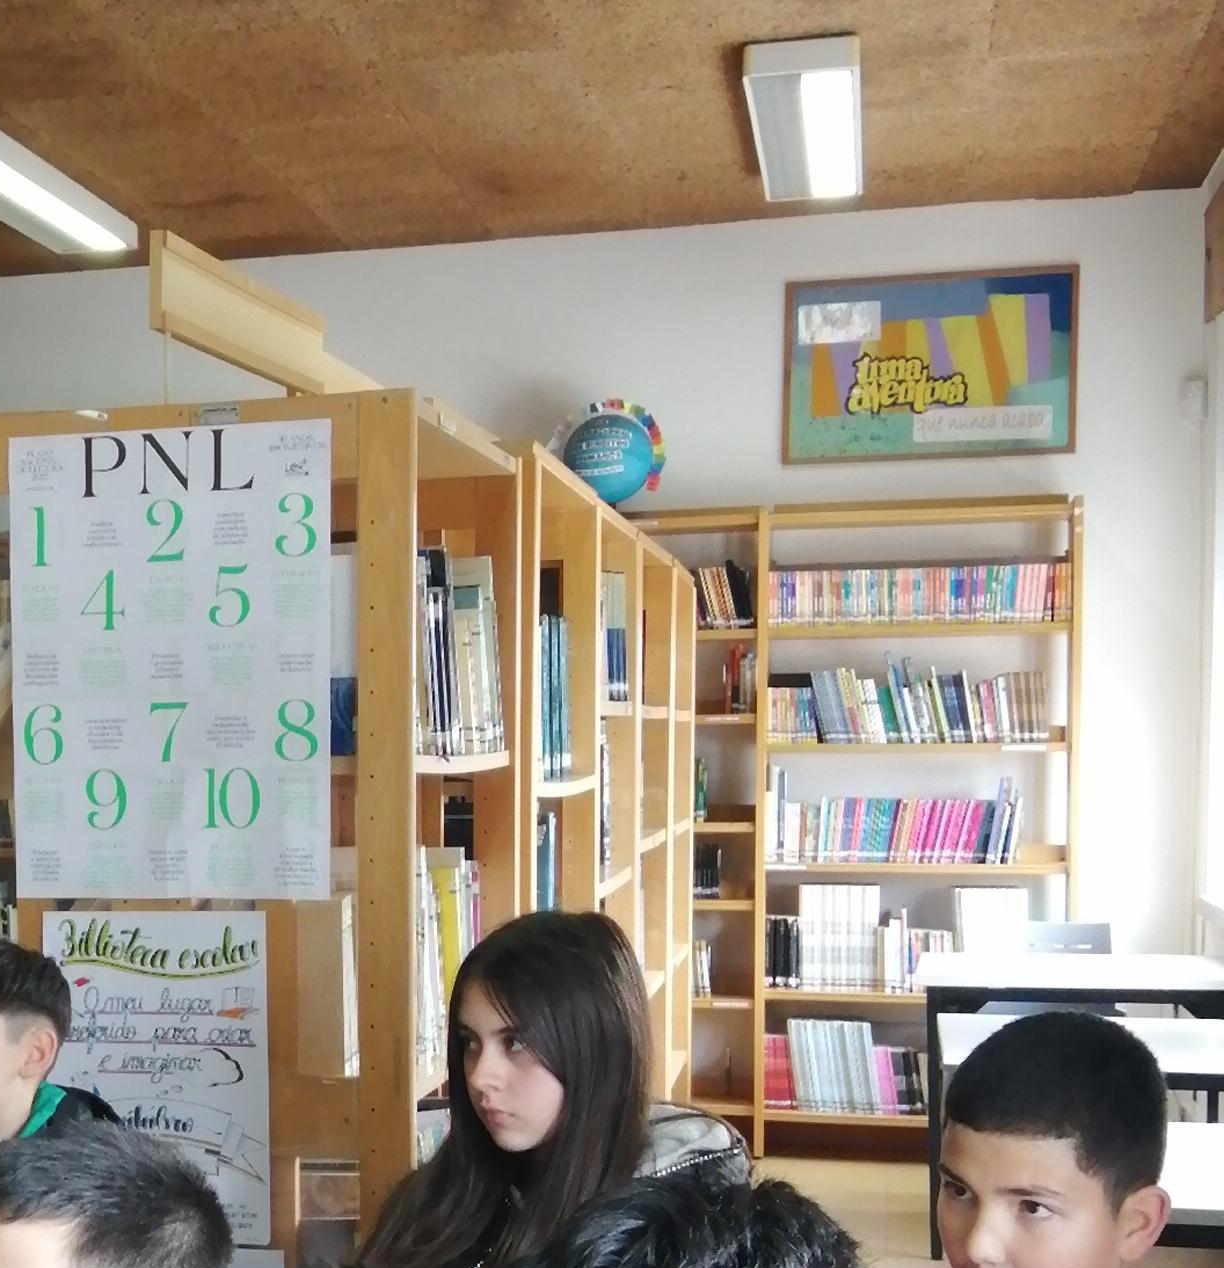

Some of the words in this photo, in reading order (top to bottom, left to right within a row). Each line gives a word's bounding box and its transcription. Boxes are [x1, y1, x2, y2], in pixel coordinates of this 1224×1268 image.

[81, 428, 255, 498] PNL
[30, 505, 51, 567] 1
[146, 499, 184, 563] 2
[275, 492, 317, 557] 3
[80, 569, 126, 631] 4
[208, 563, 250, 627] 5
[24, 703, 64, 765] 6
[149, 702, 189, 763] 7
[274, 699, 319, 762] 8
[85, 768, 127, 830] 9
[203, 767, 261, 829] 10
[69, 1019, 136, 1055] referido
